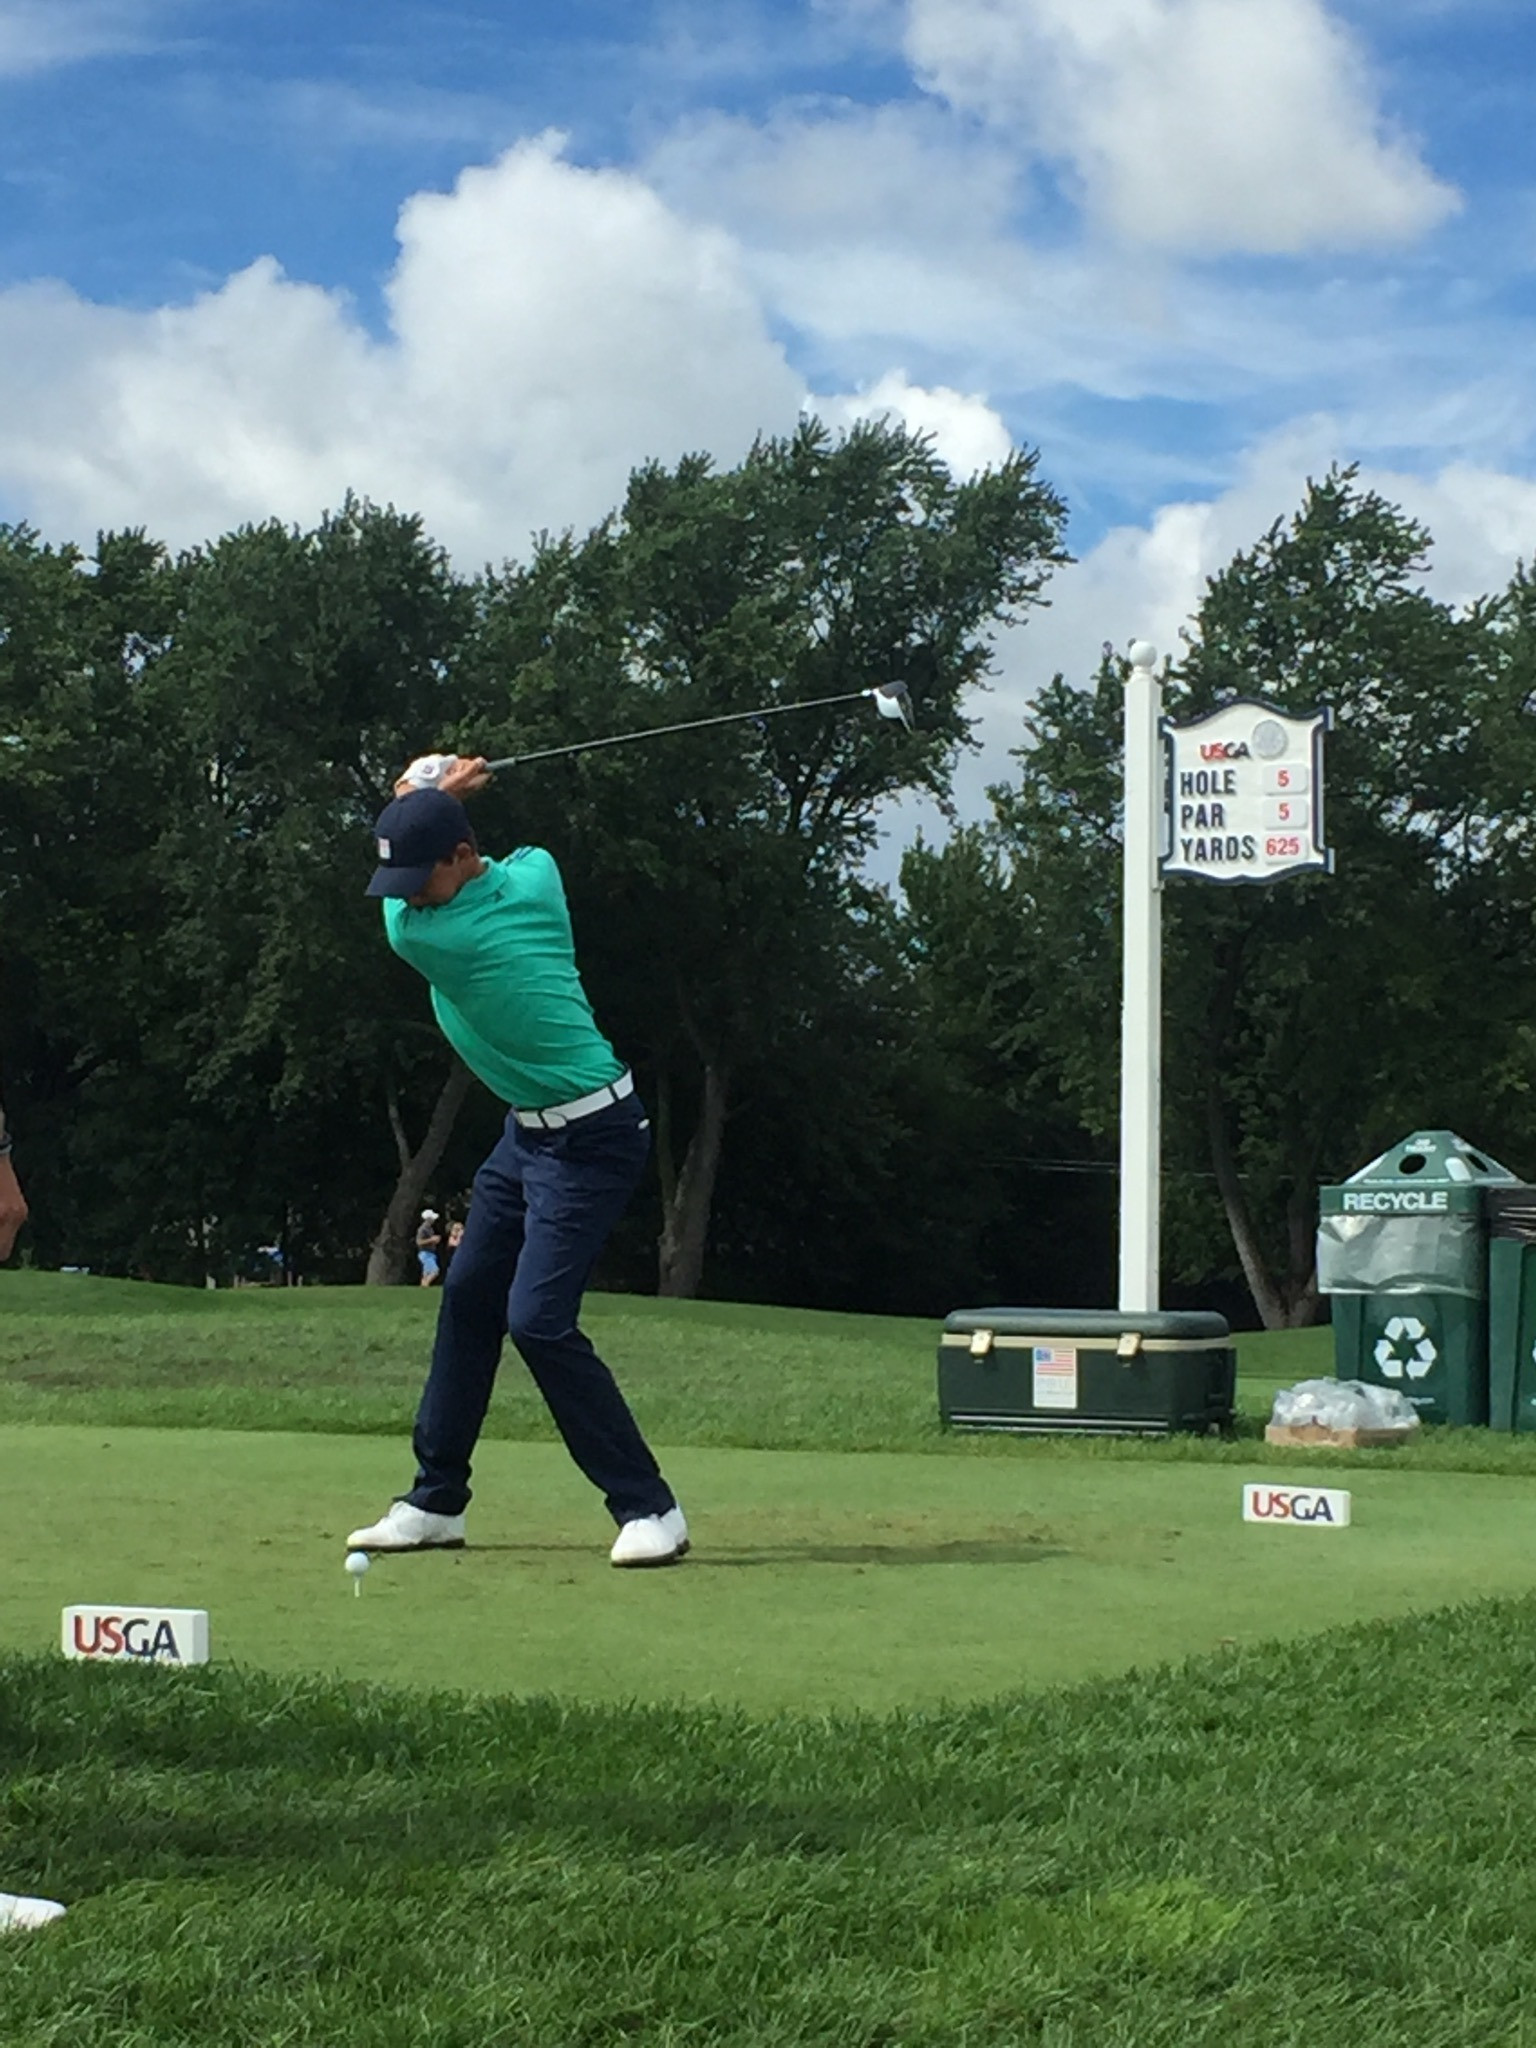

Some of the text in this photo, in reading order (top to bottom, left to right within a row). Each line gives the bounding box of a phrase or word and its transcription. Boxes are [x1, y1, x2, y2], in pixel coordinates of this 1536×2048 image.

[1200, 741, 1251, 761] USGA
[1180, 769, 1289, 796] HOLE 5
[1181, 802, 1290, 829] PAR 5
[1181, 835, 1299, 862] YARDS 625
[1343, 1192, 1447, 1210] RECYCLE
[1252, 1491, 1334, 1522] USGA
[74, 1615, 181, 1660] USGA
